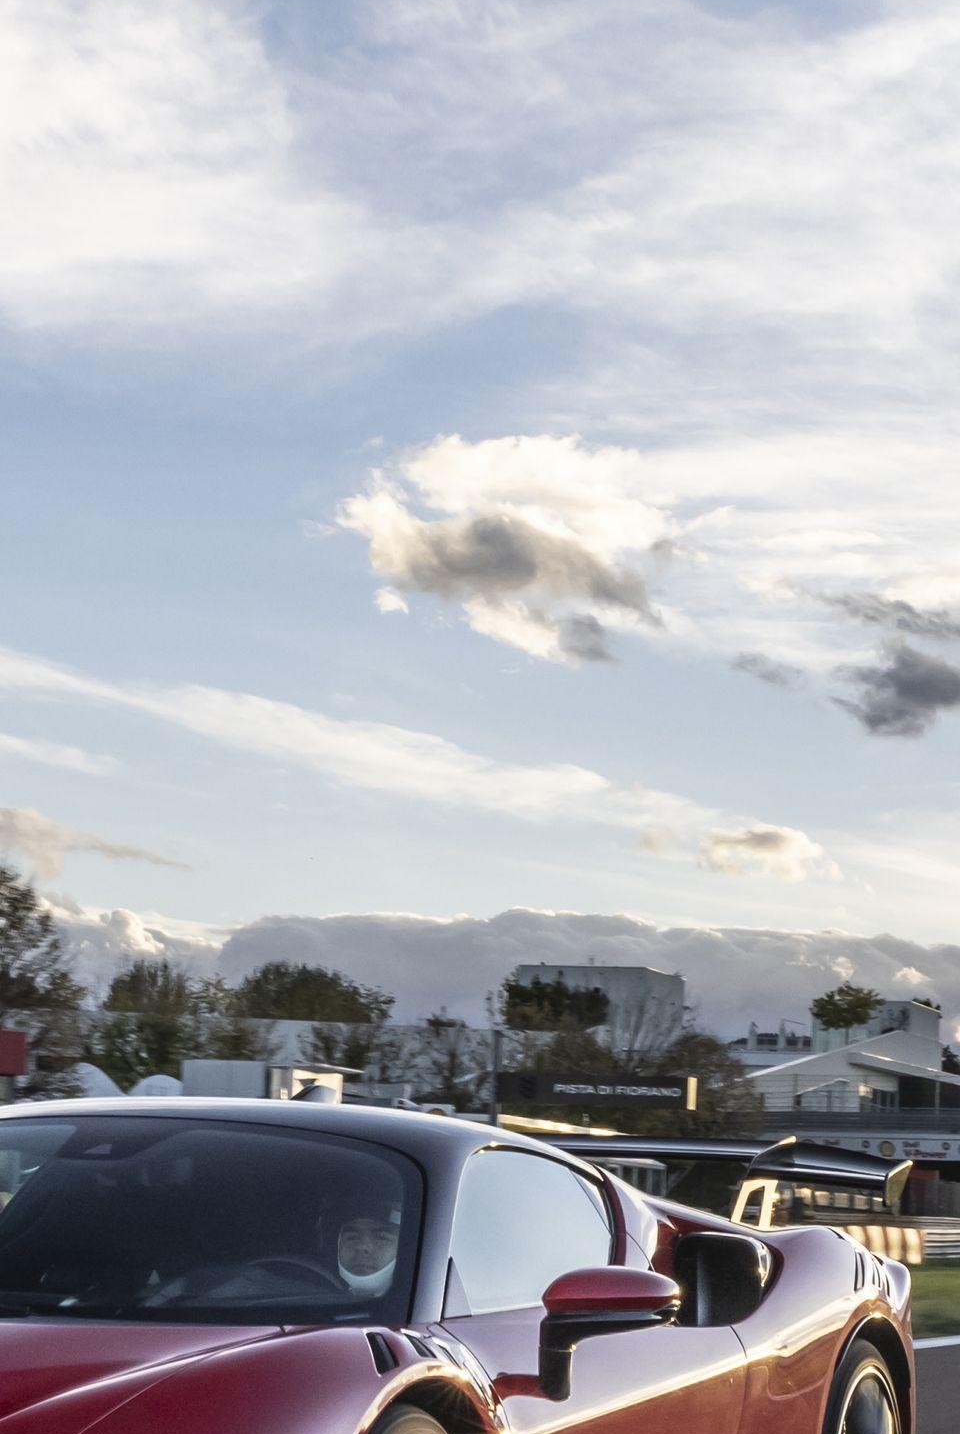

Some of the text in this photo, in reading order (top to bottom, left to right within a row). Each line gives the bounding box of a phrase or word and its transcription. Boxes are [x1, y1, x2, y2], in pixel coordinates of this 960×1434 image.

[553, 1083, 681, 1096] PISTA DI FIORANO
